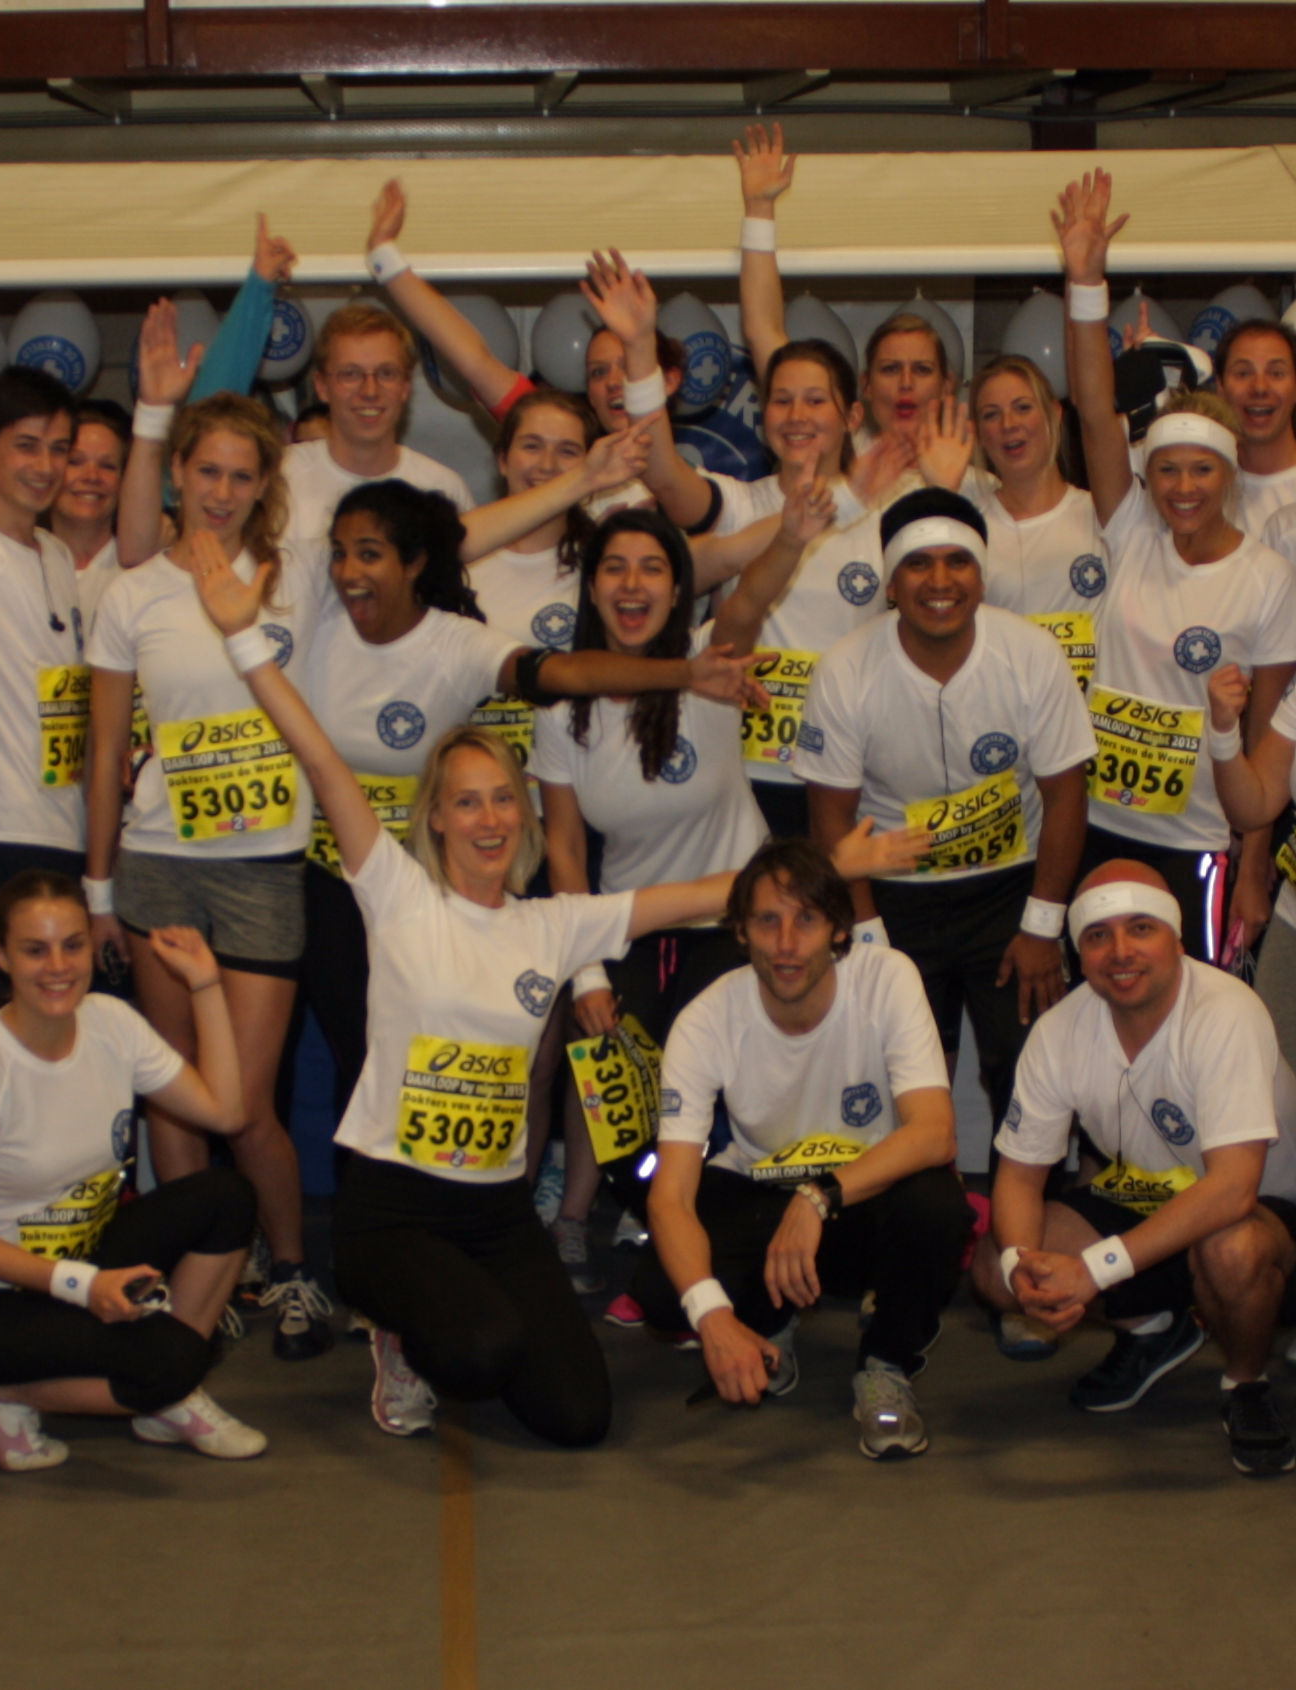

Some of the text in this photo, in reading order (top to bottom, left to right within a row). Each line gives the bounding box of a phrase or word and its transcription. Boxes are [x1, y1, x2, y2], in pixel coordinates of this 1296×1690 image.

[1047, 622, 1074, 638] ics
[781, 659, 813, 678] asi
[742, 712, 797, 744] 530
[1130, 705, 1182, 728] asics
[208, 718, 263, 744] asics
[1129, 726, 1141, 741] by
[1172, 737, 1198, 749] 2015
[1120, 744, 1138, 755] van
[1141, 748, 1154, 759] de
[1158, 751, 1195, 766] Wereld
[180, 775, 290, 820] 53036
[953, 784, 1000, 821] asics
[459, 1053, 512, 1077] asics
[590, 1034, 638, 1148] 53034
[405, 1110, 514, 1150] 53033
